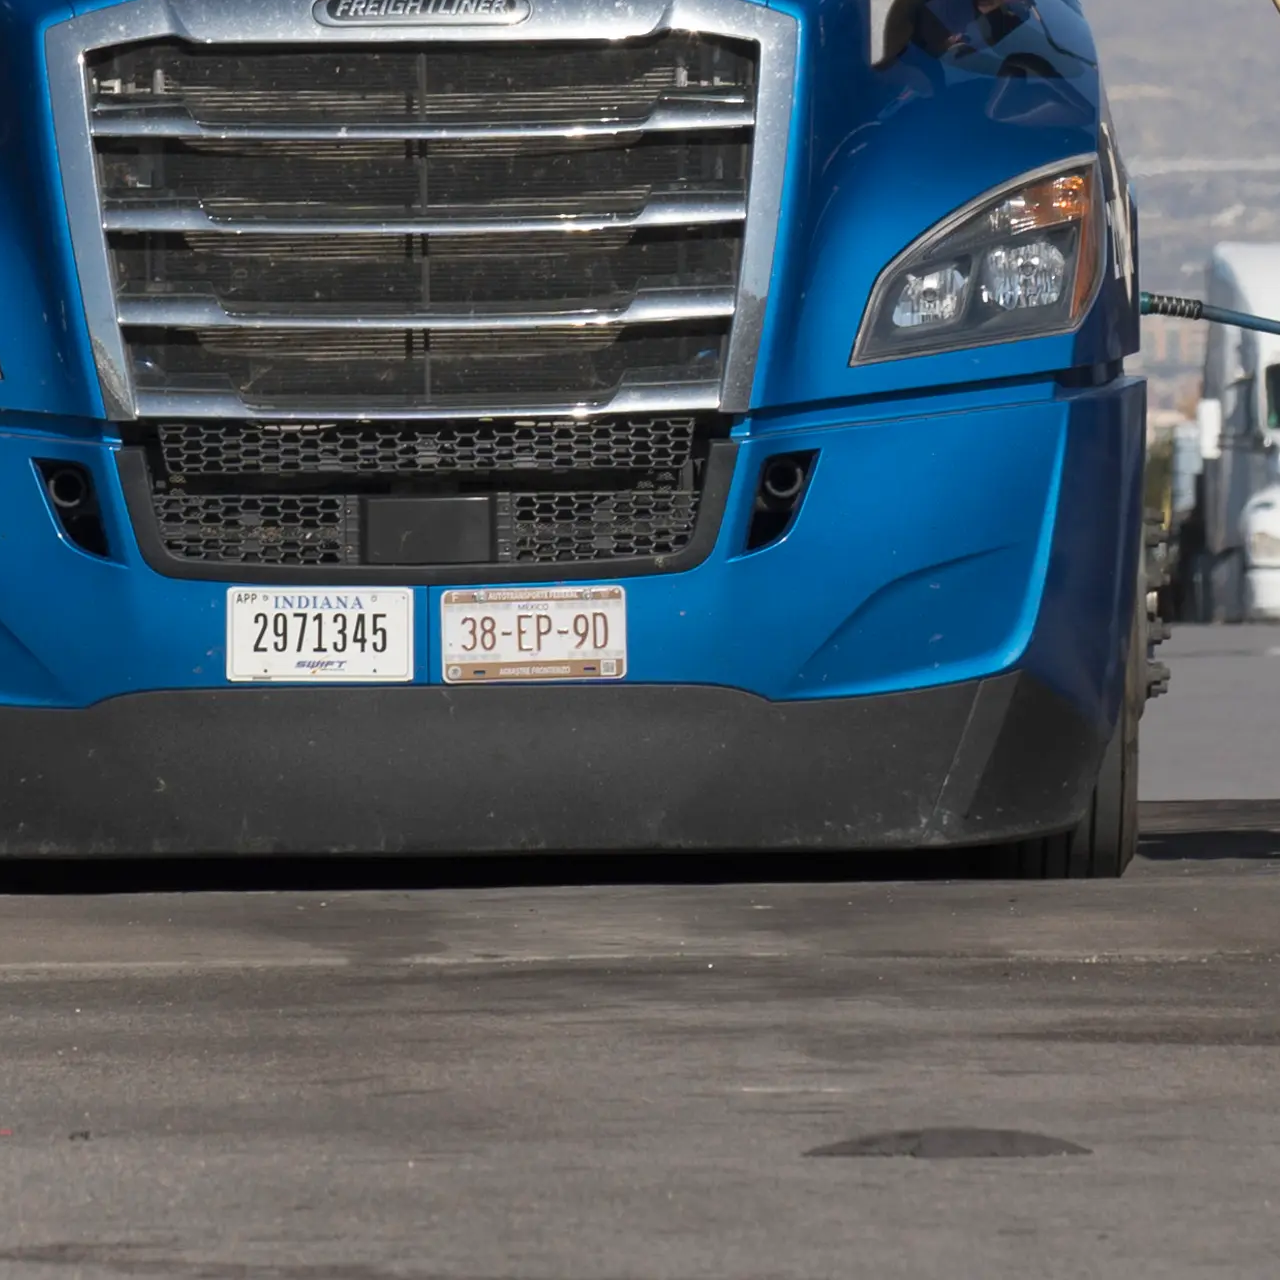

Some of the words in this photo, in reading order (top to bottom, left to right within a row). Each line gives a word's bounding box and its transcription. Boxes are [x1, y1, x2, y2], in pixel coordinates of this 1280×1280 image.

[236, 593, 258, 604] APP
[273, 595, 364, 610] INDIANA
[253, 612, 387, 653] 2971345
[461, 612, 609, 652] 38-EP-9D
